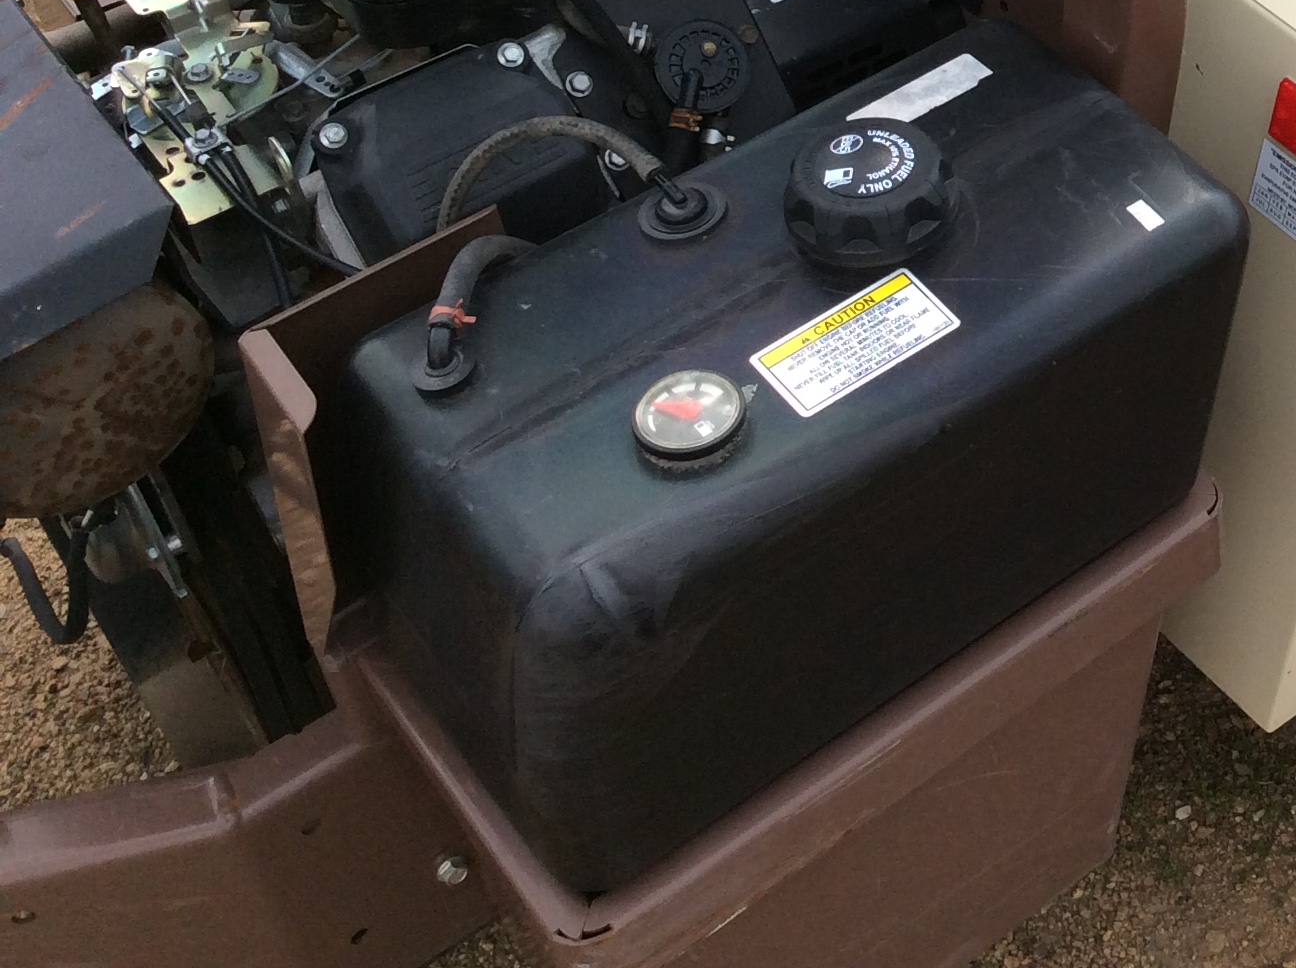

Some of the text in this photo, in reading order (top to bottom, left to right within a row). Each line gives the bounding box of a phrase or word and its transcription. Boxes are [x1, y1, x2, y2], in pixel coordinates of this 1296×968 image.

[857, 129, 915, 194] UNLEADED FUEL ONLY
[811, 294, 876, 336] CAUTION
